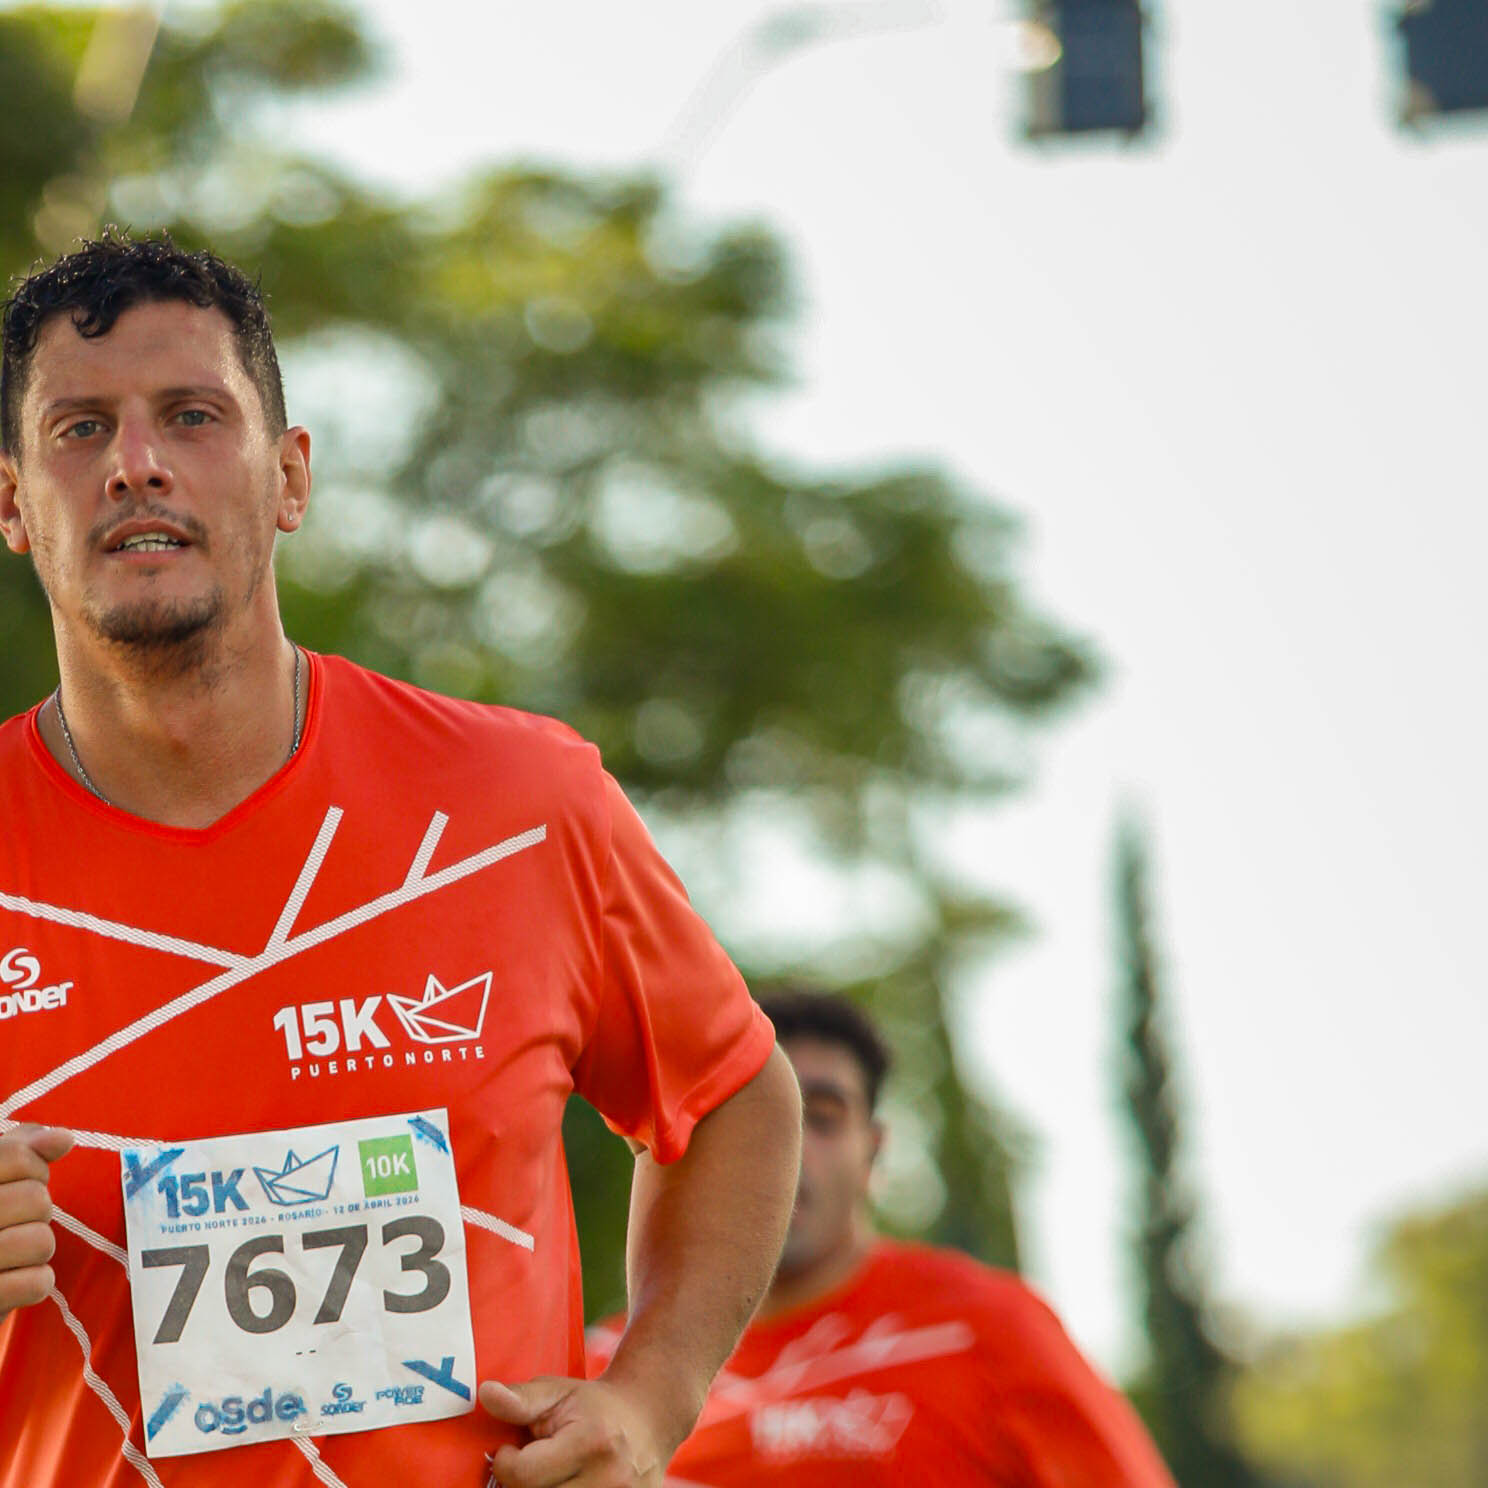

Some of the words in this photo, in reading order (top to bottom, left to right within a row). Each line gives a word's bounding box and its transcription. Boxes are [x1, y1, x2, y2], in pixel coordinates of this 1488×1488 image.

[272, 995, 392, 1061] 15K
[290, 1054, 394, 1080] PUERTO
[405, 1046, 485, 1065] NORTE
[365, 1152, 411, 1180] 10K
[157, 1167, 250, 1219] 15K
[160, 1221, 201, 1234] PUERTO
[204, 1218, 238, 1230] NORTE
[242, 1214, 267, 1226] 2026
[333, 1205, 345, 1215] 12
[348, 1203, 361, 1213] DE
[363, 1199, 393, 1210] ABRIL
[396, 1195, 420, 1207] 2026
[141, 1215, 452, 1345] 7673
[194, 1387, 305, 1434] osde
[375, 1385, 424, 1400] POWER
